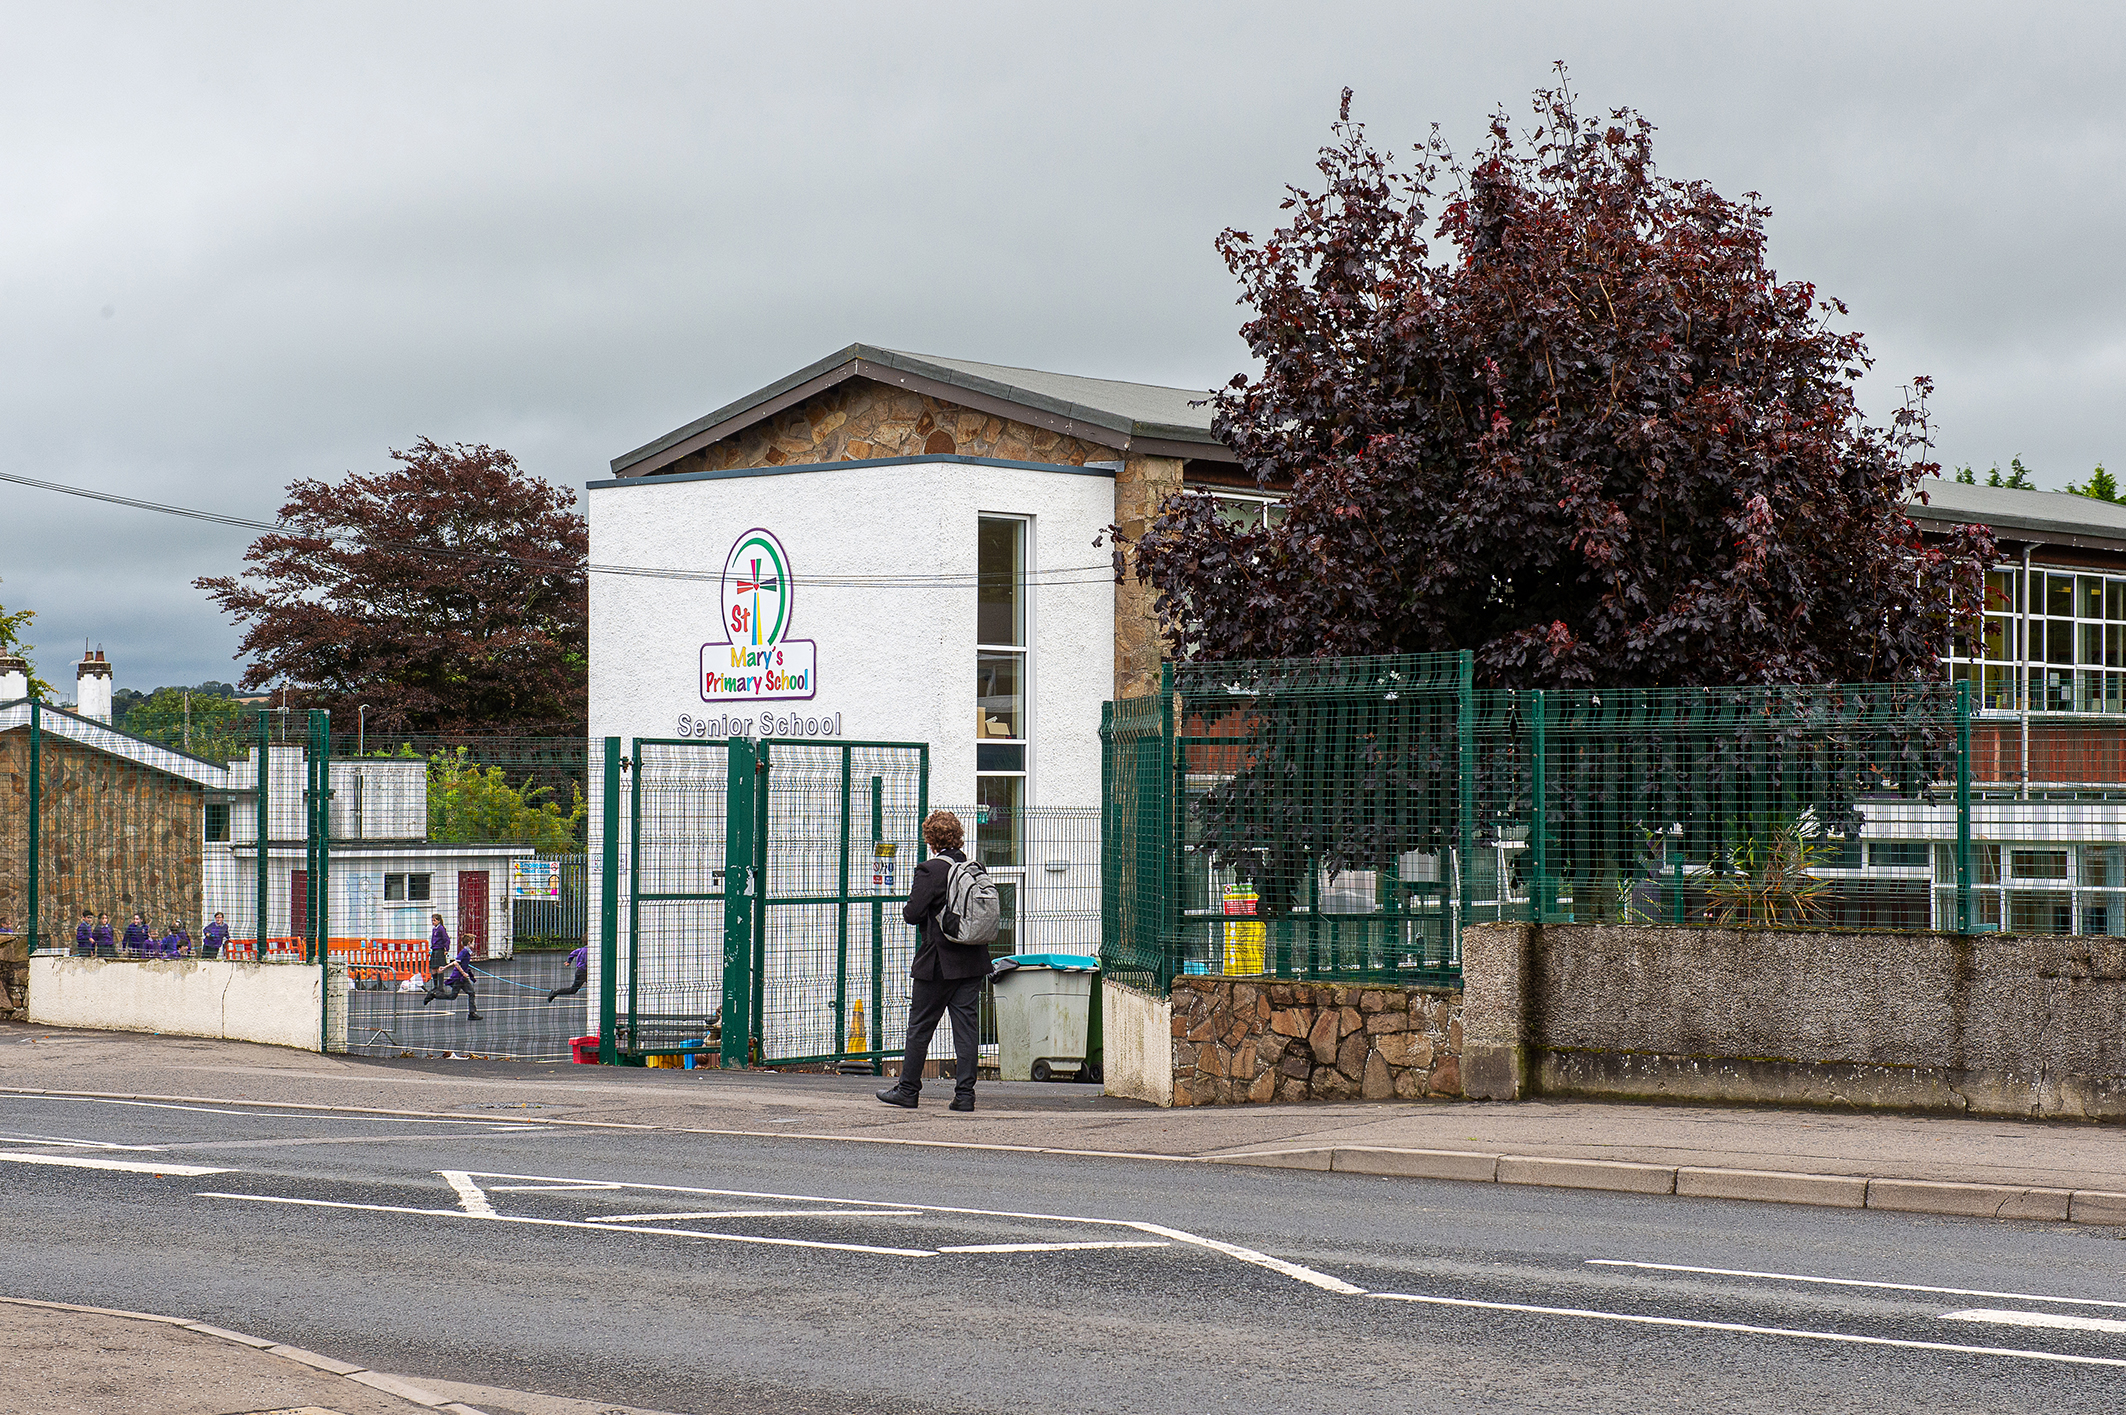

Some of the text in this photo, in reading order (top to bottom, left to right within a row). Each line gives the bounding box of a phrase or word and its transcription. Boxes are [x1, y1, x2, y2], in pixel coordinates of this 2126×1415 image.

[730, 604, 750, 632] St
[730, 646, 783, 670] Mary's
[706, 668, 808, 695] Primary School
[677, 711, 841, 737] Senior School
